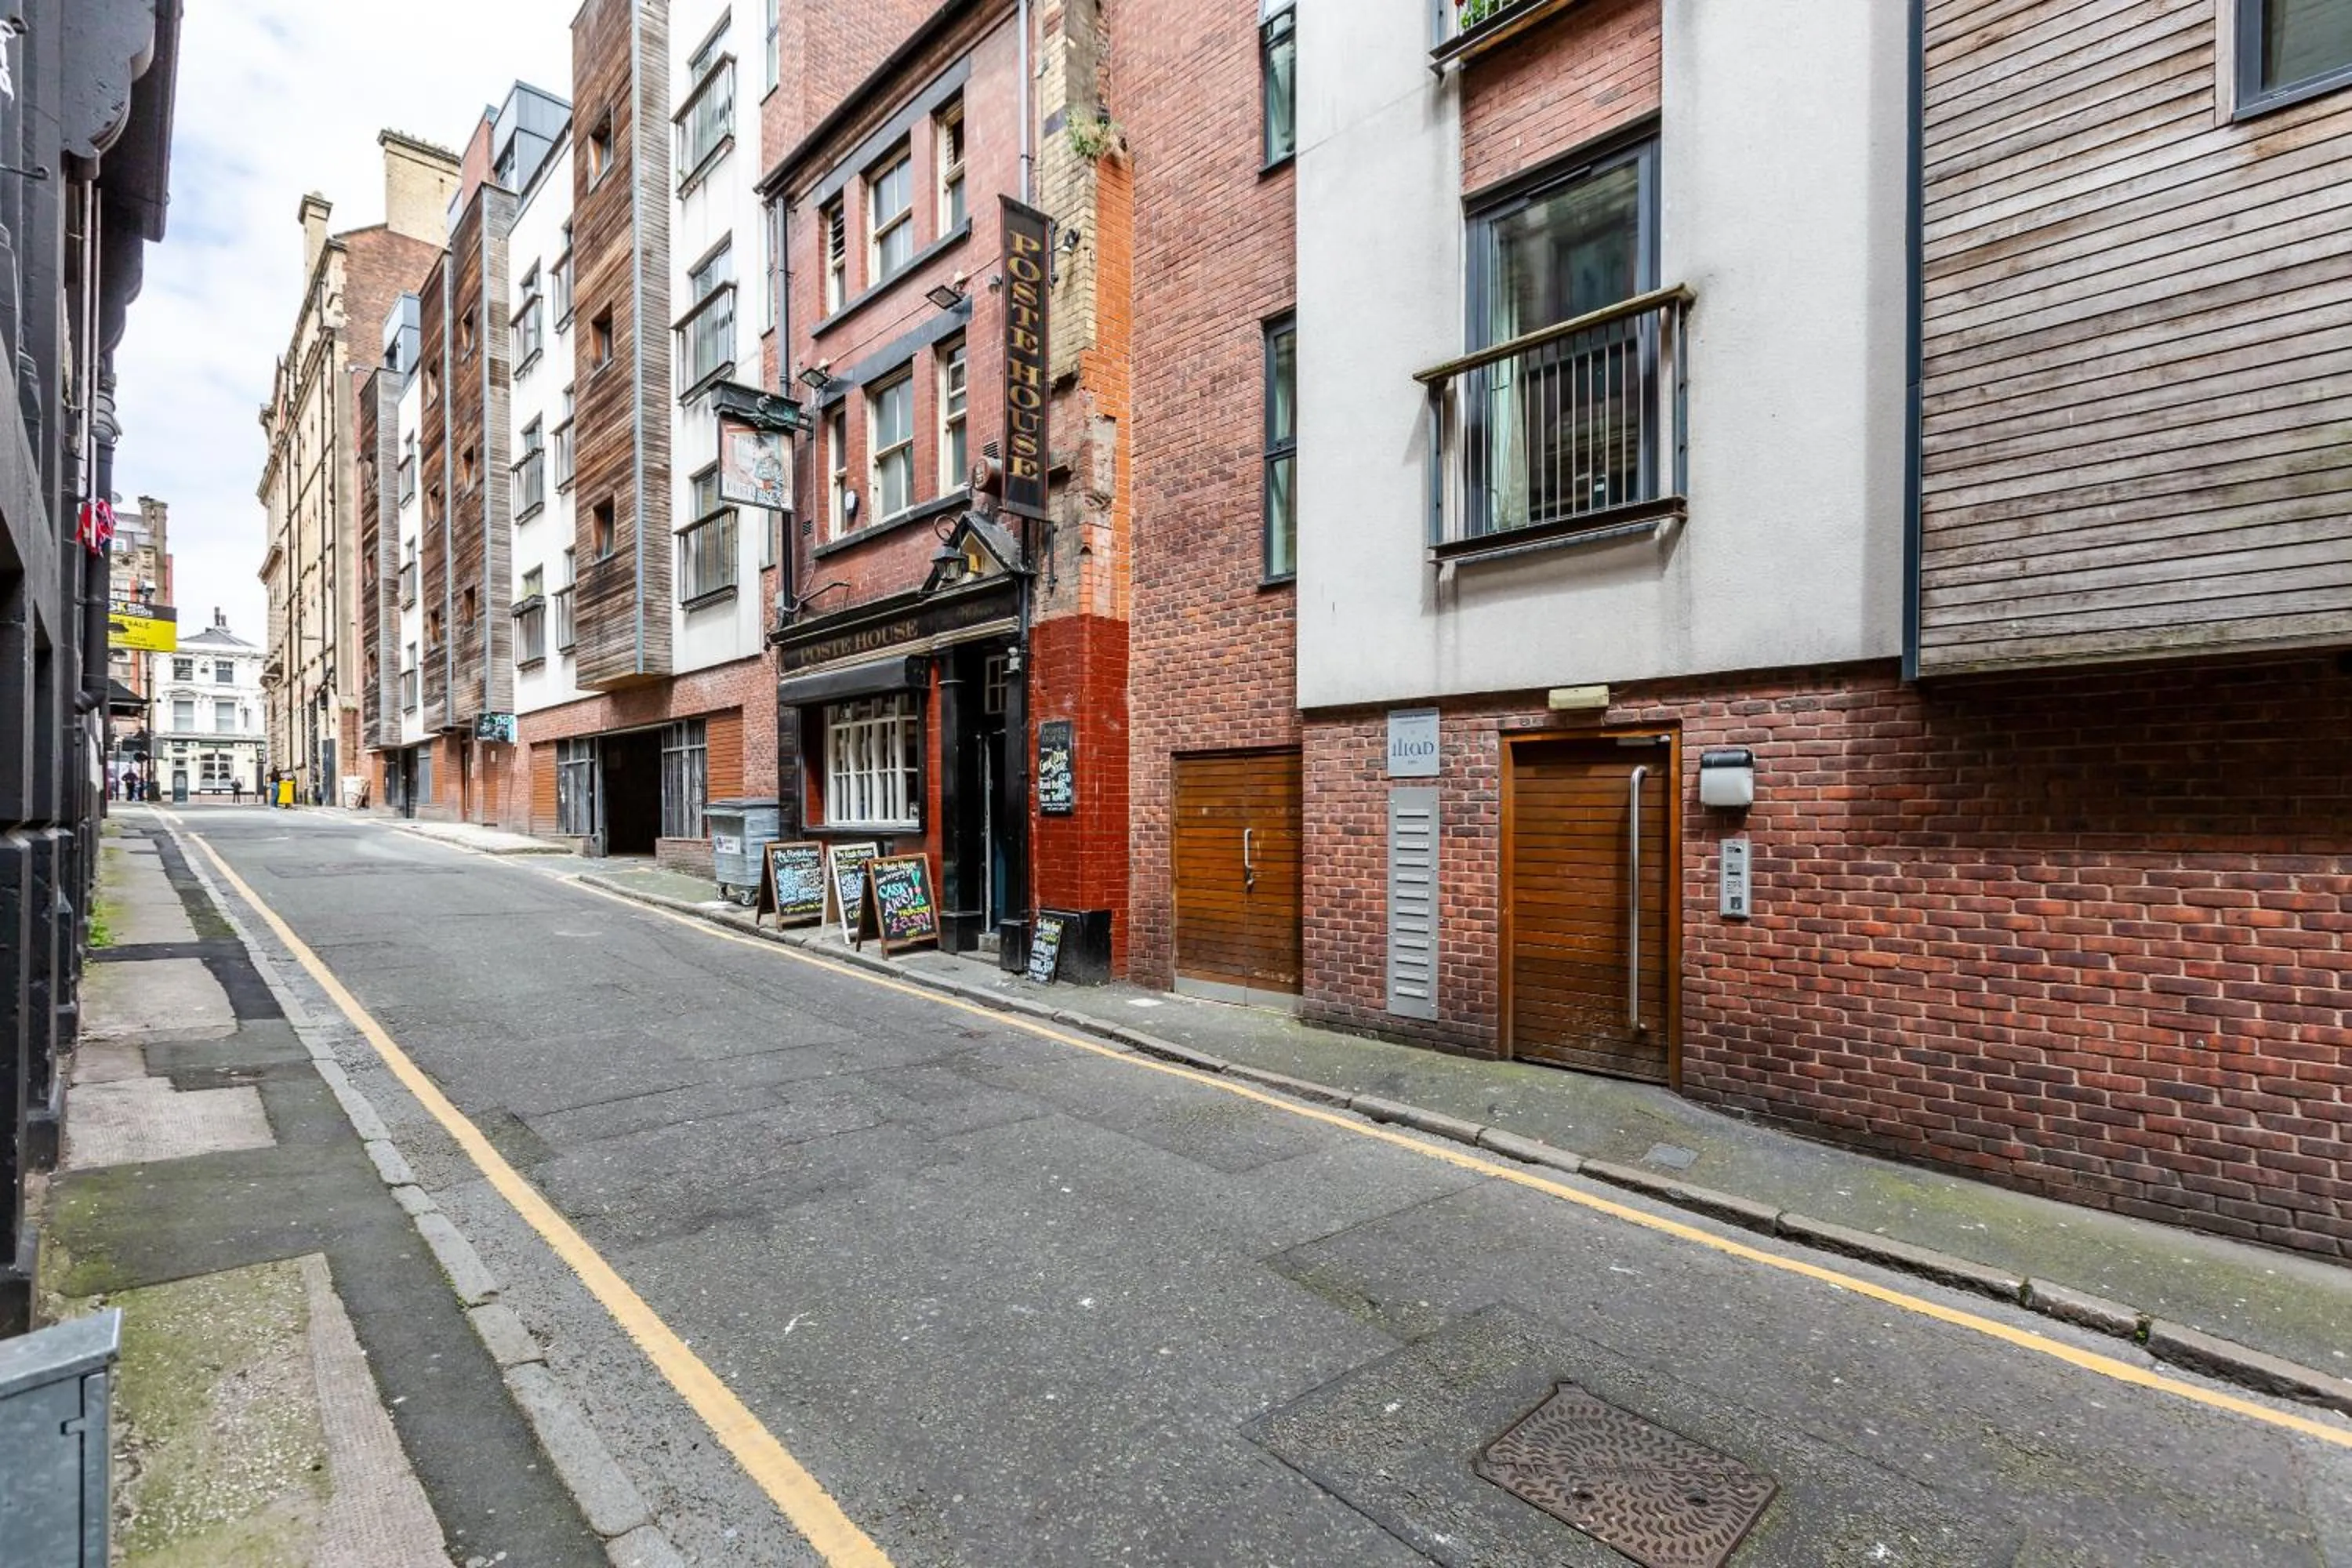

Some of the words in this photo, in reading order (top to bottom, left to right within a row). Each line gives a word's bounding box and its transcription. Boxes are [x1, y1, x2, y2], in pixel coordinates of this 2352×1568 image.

[1007, 230, 1041, 356] POSTE
[1007, 358, 1042, 481] HOUSE
[800, 637, 851, 663] POSTE
[855, 619, 919, 650] HOUSE
